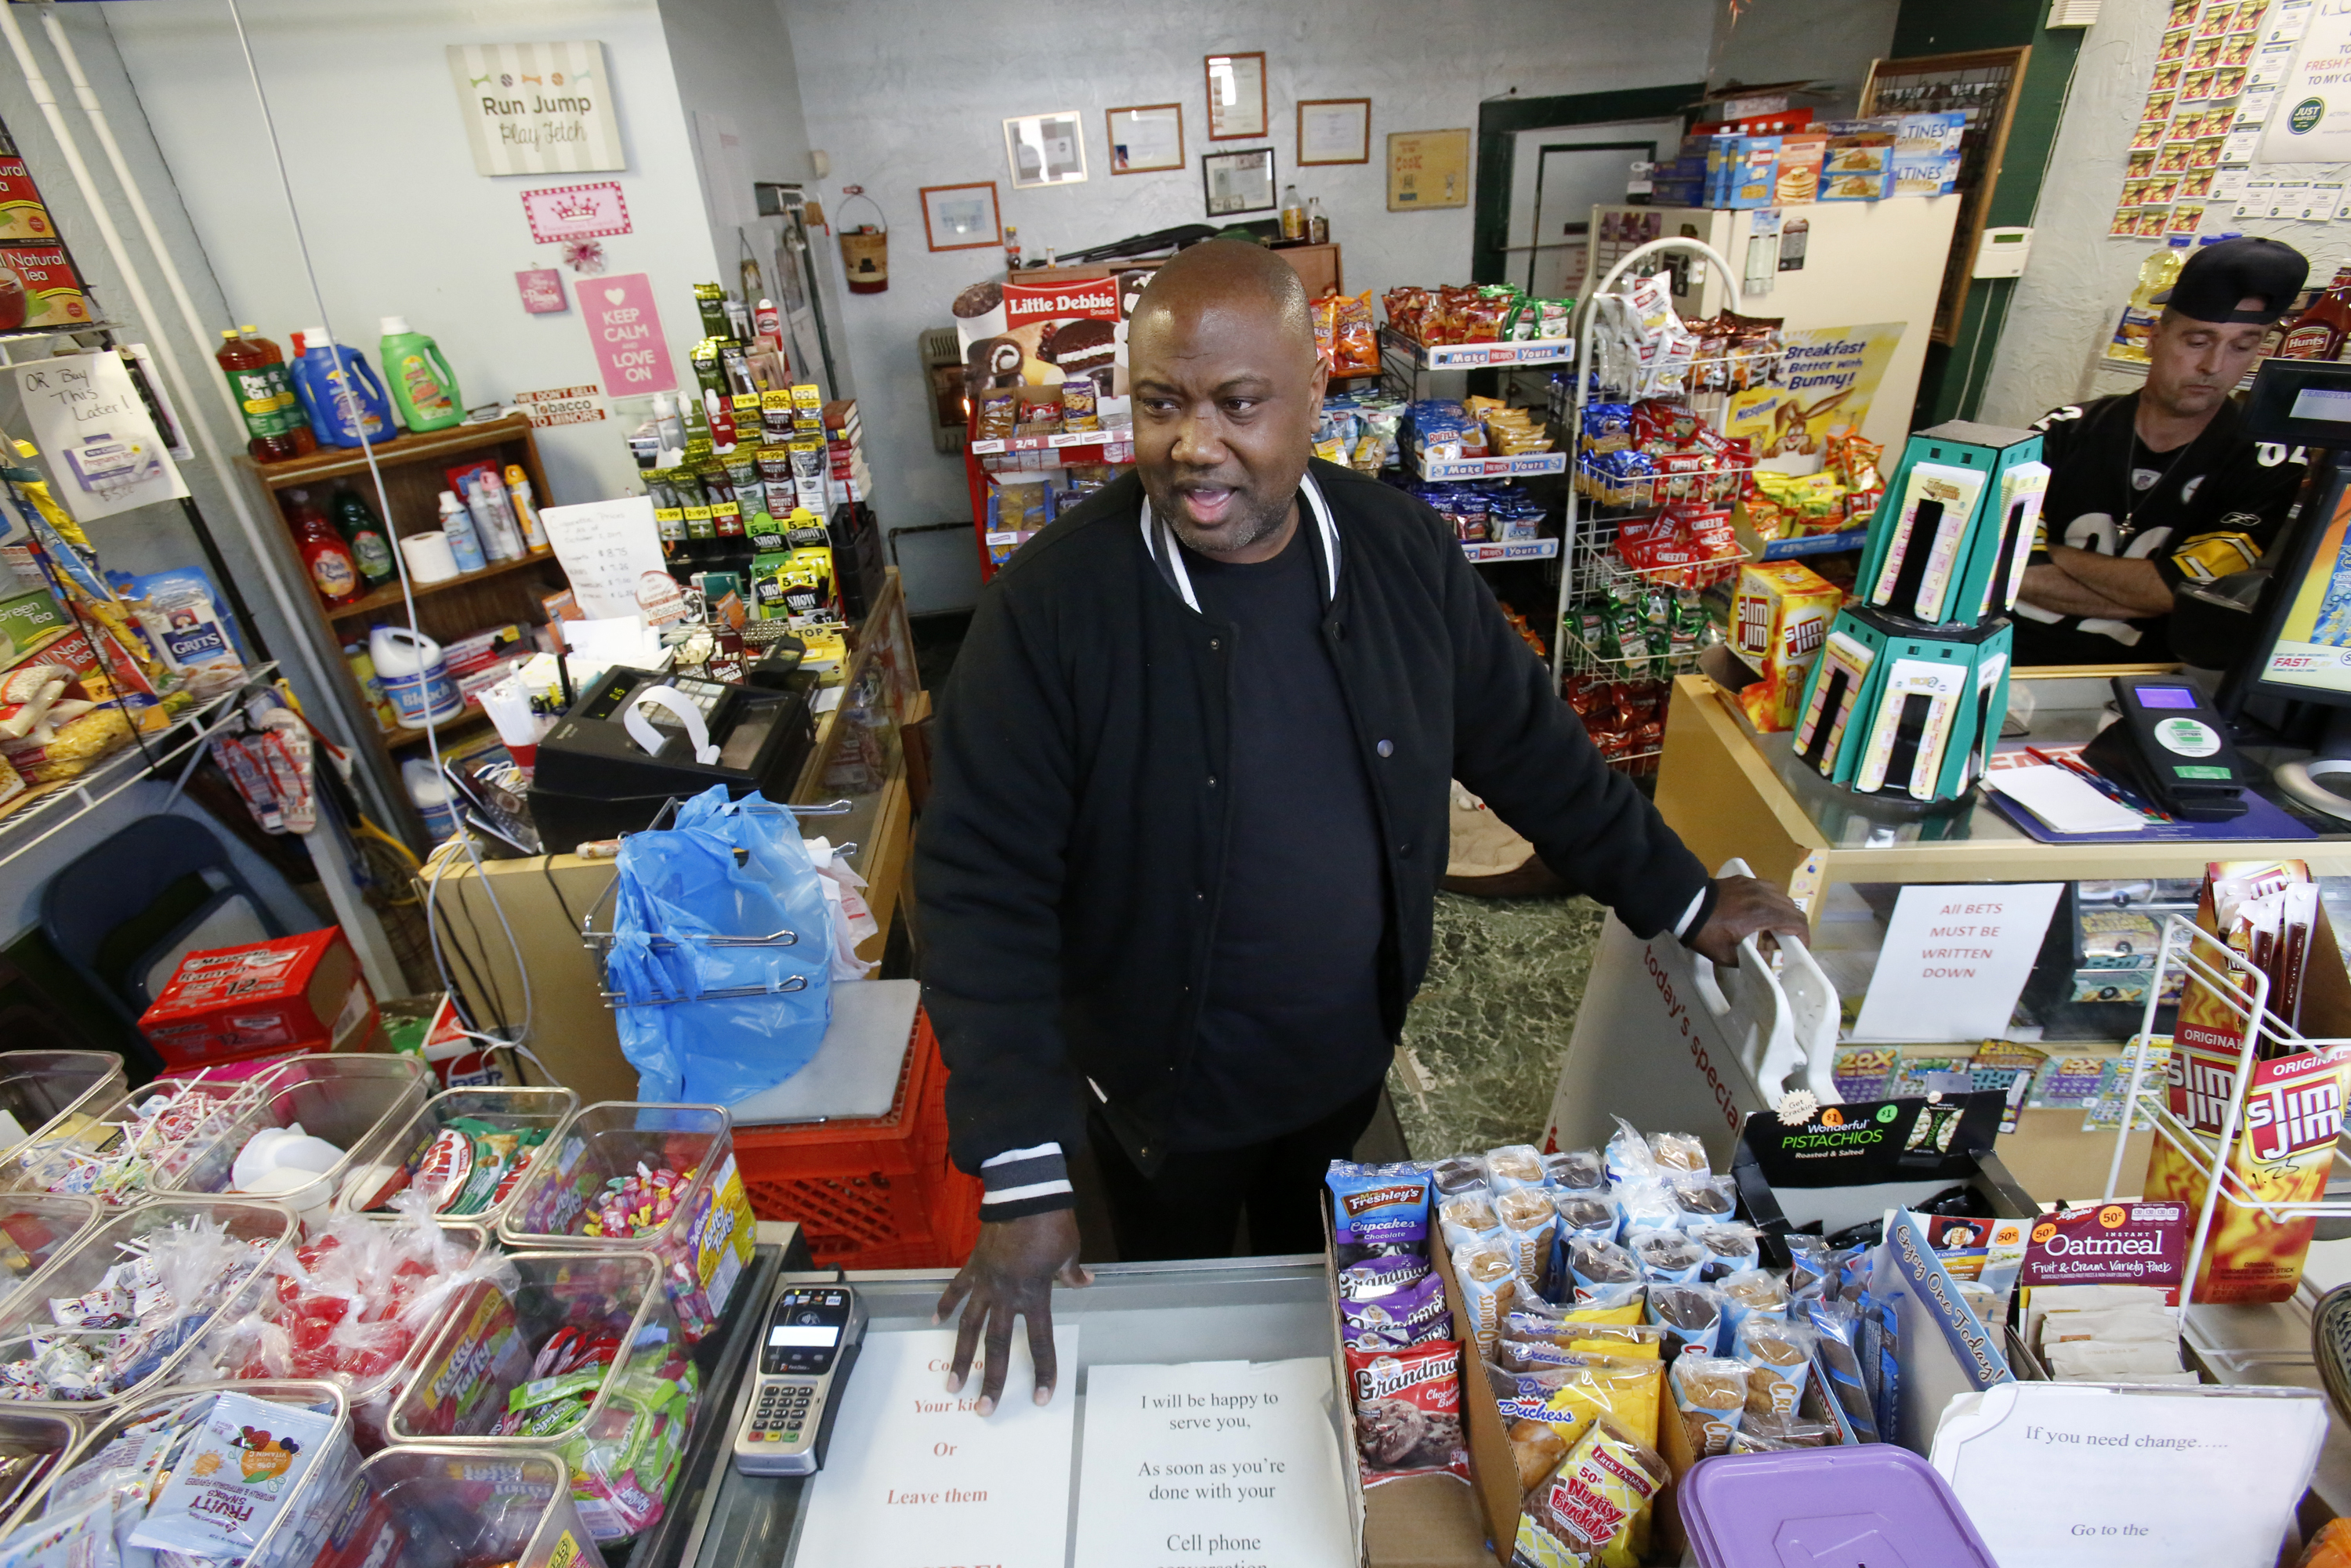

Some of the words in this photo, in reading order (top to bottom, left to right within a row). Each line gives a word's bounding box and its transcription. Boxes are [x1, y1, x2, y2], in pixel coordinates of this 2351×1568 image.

[2305, 60, 2343, 71] FRESH
[2308, 76, 2322, 85] TO
[2323, 75, 2342, 84] MY
[482, 97, 525, 115] Run
[534, 95, 592, 115] Jump
[2295, 107, 2320, 116] JUST
[499, 123, 539, 152] Play
[543, 121, 587, 143] Fetch
[9, 251, 66, 267] Natural
[23, 268, 49, 281] Tea
[1009, 298, 1053, 314] Little
[1056, 293, 1114, 311] Debbie
[602, 309, 639, 325] KEEP
[604, 324, 649, 342] CALM
[1784, 340, 1866, 360] Breakfast
[2288, 335, 2324, 349] Hunt's
[612, 350, 655, 368] LOVE
[1451, 353, 1486, 365] Make
[1520, 347, 1553, 360] Yours
[625, 368, 652, 382] ON
[1788, 361, 1833, 374] Better
[26, 373, 49, 392] OR
[58, 369, 89, 385] Buy
[1788, 372, 1856, 391] Bunny!
[50, 388, 98, 405] This
[516, 393, 534, 404] WE
[573, 385, 598, 398] SELL
[73, 394, 132, 422] Later!
[532, 399, 591, 415] Tobacco
[531, 417, 547, 428] TO
[549, 410, 601, 425] MINORS
[1429, 430, 1460, 444] RUFFLES
[1447, 464, 1480, 475] Make
[1514, 459, 1545, 472] Yours
[751, 525, 759, 534] 5
[753, 535, 782, 546] SHOW
[1509, 545, 1538, 557] Yours
[787, 594, 816, 607] SHOW
[27, 610, 54, 625] Tea
[647, 603, 685, 620] Tobacco
[1737, 596, 1768, 625] slim
[795, 628, 824, 638] TOP
[1784, 619, 1824, 643] slim
[172, 632, 221, 656] GRITS
[33, 650, 53, 669] All
[2273, 658, 2312, 667] FAST
[712, 661, 740, 677] Black
[723, 669, 742, 682] Mild
[1965, 904, 2002, 914] BETS
[1929, 926, 1977, 937] MUST
[1980, 926, 2001, 937] BE
[1921, 948, 1993, 959] WRITTEN
[179, 966, 249, 982] Ramen
[1922, 968, 1976, 979] DOWN
[225, 978, 259, 996] 12
[1644, 943, 1690, 1037] today's
[1782, 1101, 1814, 1118] Crackin'
[1788, 1099, 1804, 1109] Get
[2247, 1083, 2341, 1130] slim
[1827, 1112, 1838, 1122] $1
[1881, 1108, 1892, 1118] $1
[1808, 1119, 1868, 1134] Wonderful
[1924, 1111, 1945, 1147] PISTACHIOS
[1782, 1129, 1883, 1149] PISTACHIOS
[1795, 1150, 1828, 1159] Roasted
[1838, 1147, 1864, 1157] Salted
[1349, 1187, 1420, 1210] Freshley's
[1349, 1220, 1417, 1233] Cupcakes
[1364, 1230, 1406, 1240] Chocolate
[2045, 1229, 2163, 1257] Oatmeal
[2031, 1261, 2057, 1273] Fruit
[2059, 1262, 2070, 1273] &
[2071, 1261, 2107, 1273] Cream
[2109, 1260, 2144, 1277] Variety
[2145, 1260, 2172, 1273] Pack
[1896, 1225, 1927, 1280] Enjoy
[1927, 1272, 1952, 1314] One
[1952, 1305, 2006, 1385] Today!
[1477, 1294, 1498, 1343] DONUTS
[915, 1399, 953, 1414] Your
[1153, 1394, 1182, 1408] will
[1187, 1393, 1206, 1407] be
[1211, 1392, 1258, 1410] happy
[1263, 1392, 1279, 1405] to
[1498, 1399, 1575, 1424] Duchess
[1169, 1418, 1211, 1430] serve
[1216, 1415, 1251, 1432] you,
[2025, 1425, 2043, 1440] If
[2045, 1430, 2080, 1446] you
[2086, 1432, 2129, 1448] need
[255, 1450, 288, 1458] VITAMIN
[933, 1442, 958, 1457] Or
[1138, 1461, 1161, 1477] As
[1165, 1462, 1204, 1476] soon
[1209, 1462, 1227, 1475] as
[1232, 1458, 1286, 1478] you're
[1594, 1450, 1617, 1472] Little
[1617, 1468, 1647, 1494] Debbie
[185, 1477, 213, 1488] FLAVORED
[212, 1482, 244, 1494] ARTIFICIALLY
[207, 1489, 247, 1505] SNACKS
[248, 1490, 277, 1502] NATURALLY
[886, 1489, 940, 1505] Leave
[944, 1487, 989, 1502] them
[1149, 1484, 1190, 1501] done
[1195, 1483, 1232, 1499] with
[1237, 1487, 1277, 1503] your
[1567, 1476, 1626, 1524] Nutty
[188, 1495, 255, 1522] FRUITY
[1551, 1486, 1615, 1543] Buddy
[1552, 1512, 1574, 1532] WAFER
[1571, 1527, 1588, 1544] BARS
[2071, 1524, 2096, 1537] Go
[2101, 1524, 2117, 1537] to
[2122, 1523, 2150, 1537] the
[1167, 1534, 1202, 1552] Cell
[1208, 1534, 1262, 1556] phone
